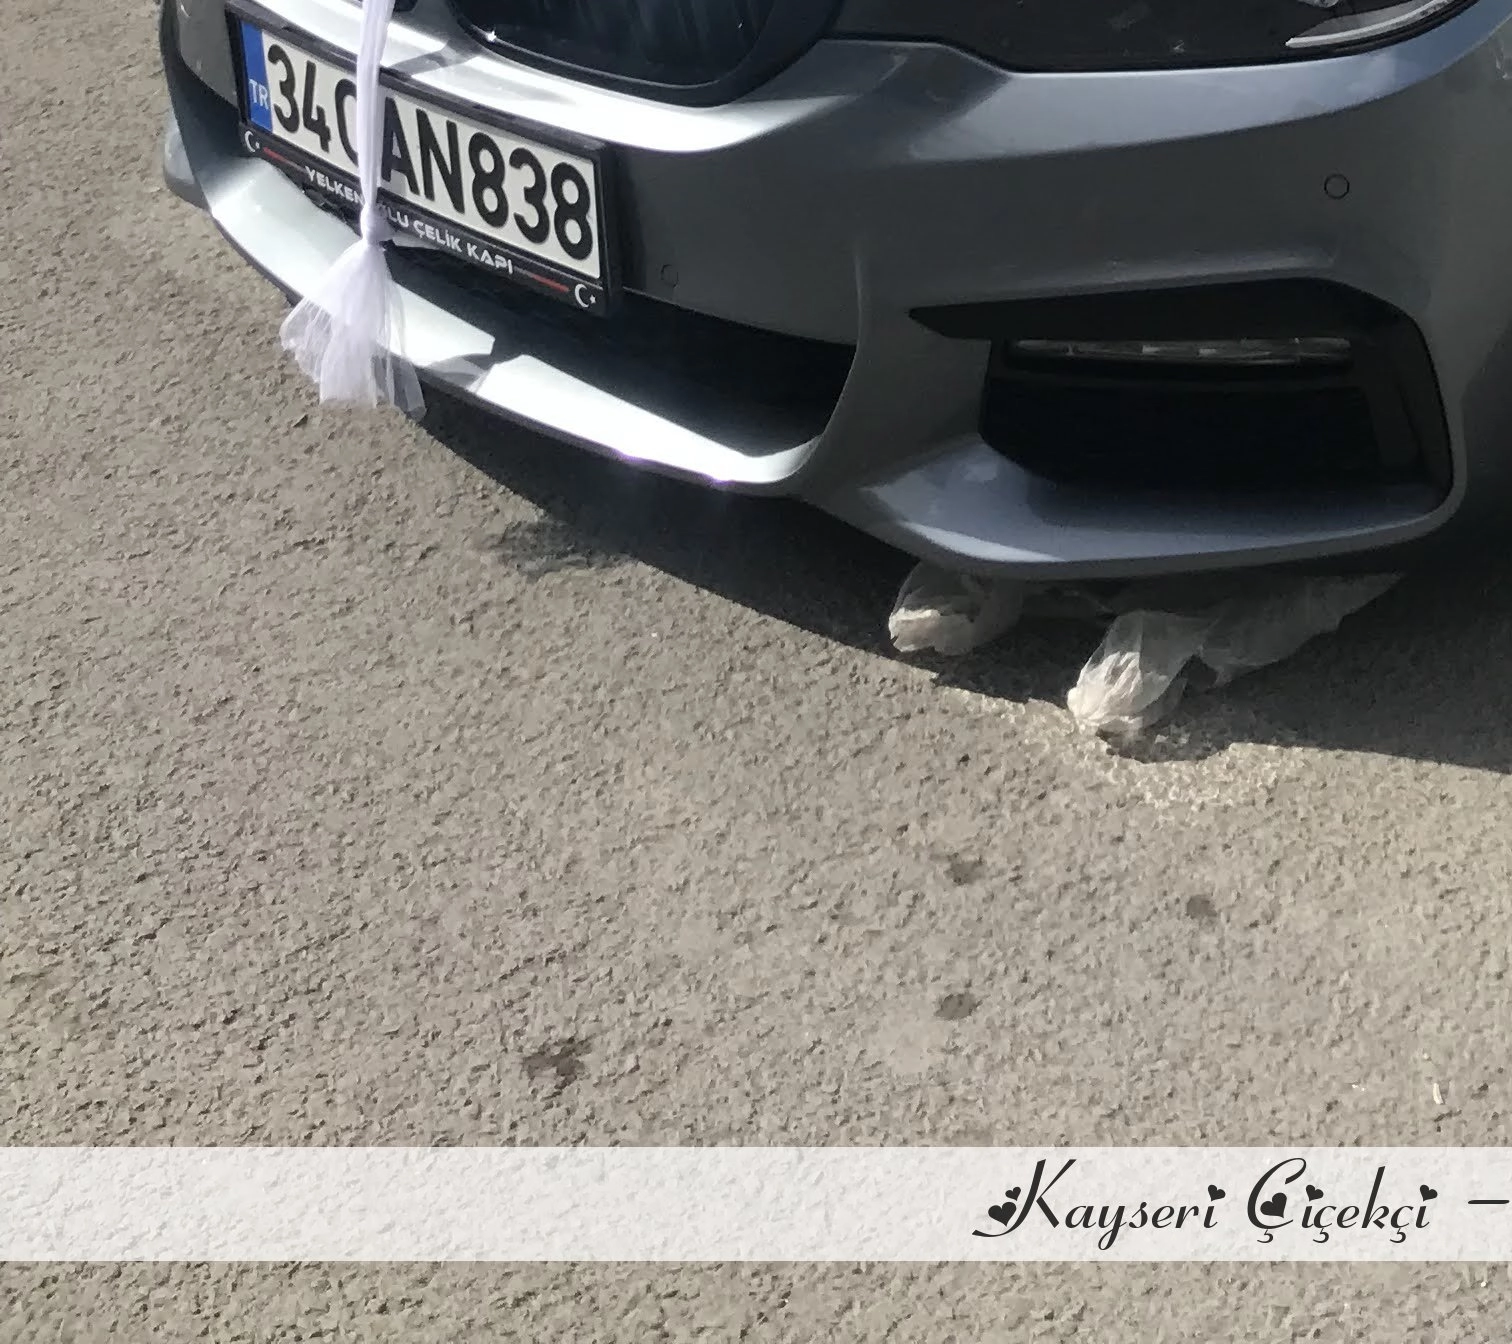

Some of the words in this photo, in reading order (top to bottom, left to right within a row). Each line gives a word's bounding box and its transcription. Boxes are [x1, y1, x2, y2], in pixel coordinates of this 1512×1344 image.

[248, 78, 269, 110] TR
[413, 220, 463, 254] ÇELİK
[466, 242, 514, 275] KAPI
